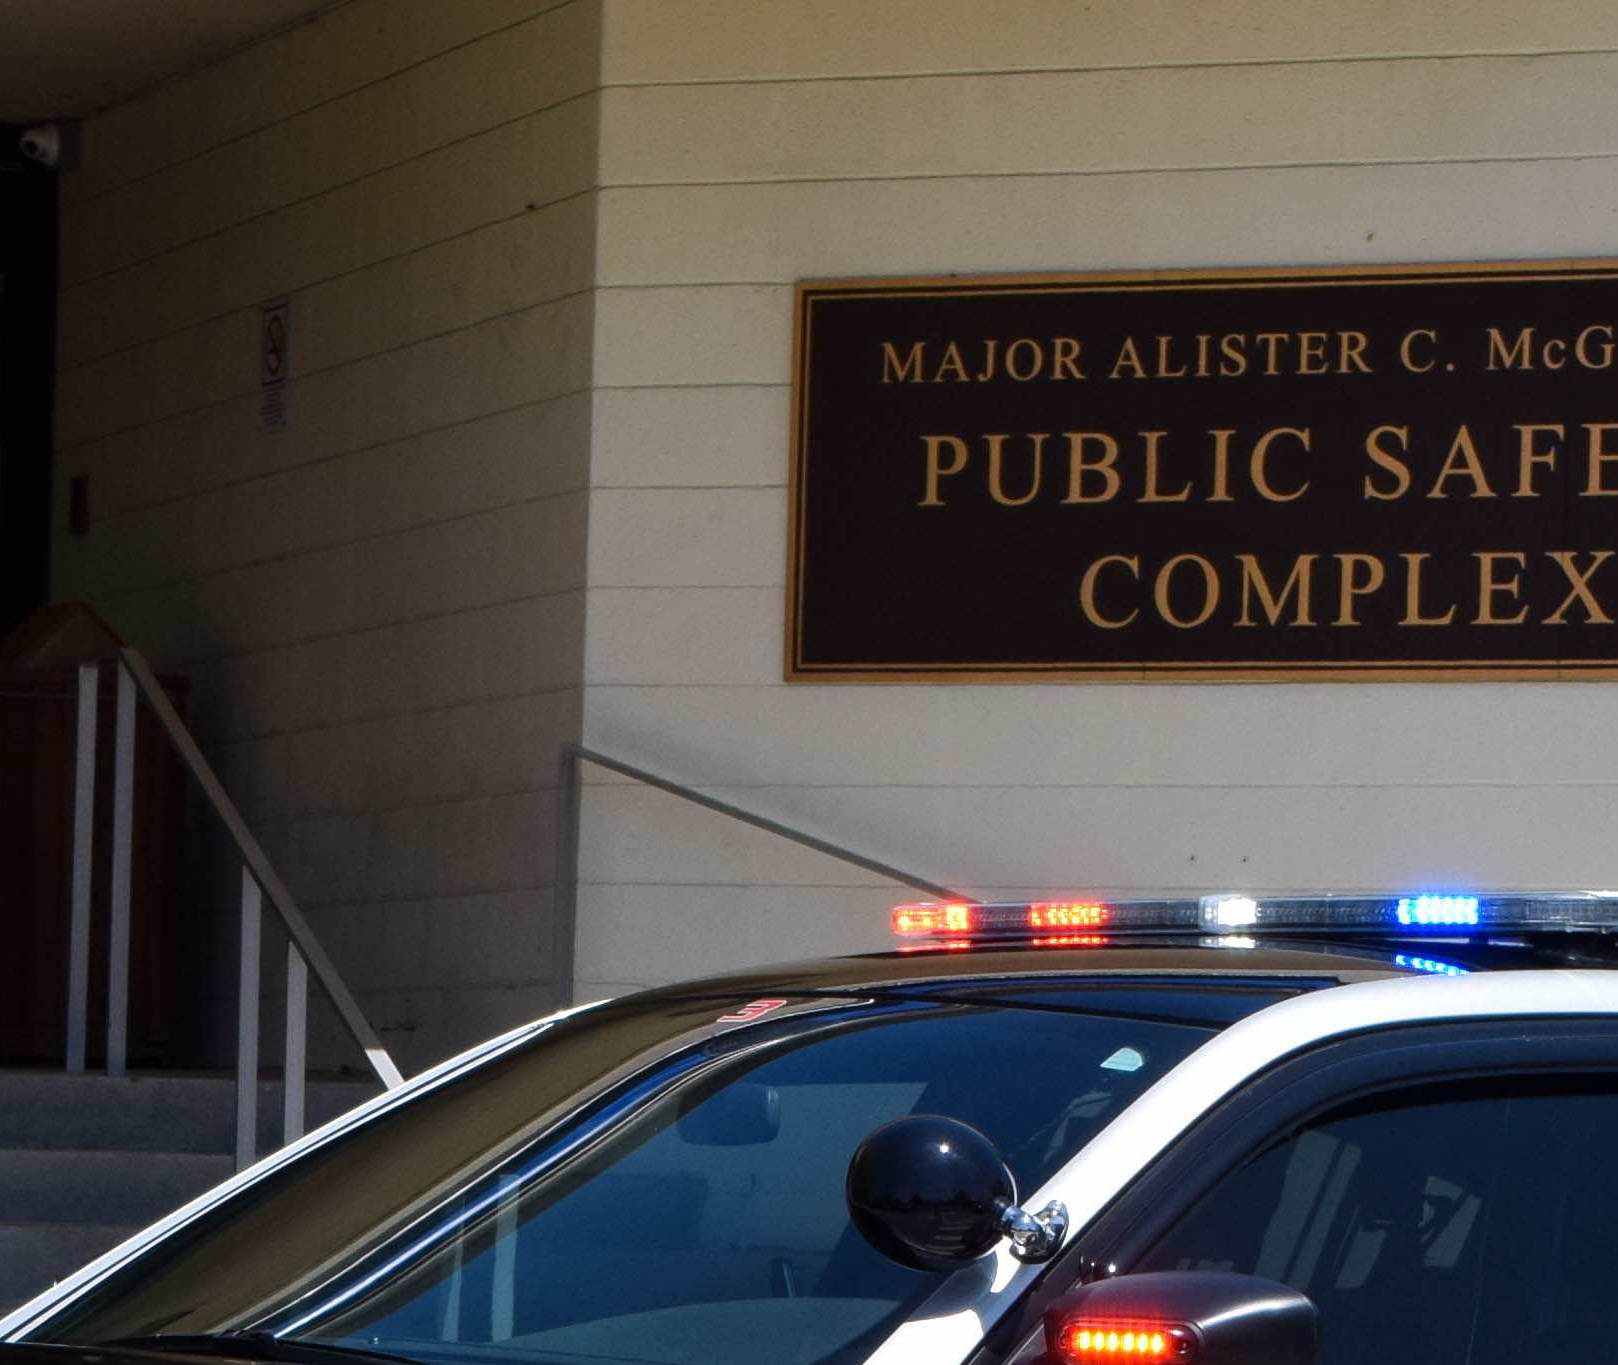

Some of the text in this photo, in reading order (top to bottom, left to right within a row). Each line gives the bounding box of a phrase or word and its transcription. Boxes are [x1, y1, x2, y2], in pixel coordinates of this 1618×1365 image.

[881, 337, 1086, 383] MAJOR
[1108, 331, 1373, 378] ALISTER
[1399, 329, 1456, 373] C.
[918, 427, 1311, 506] PUBLIC
[1079, 550, 1616, 629] COMPLEX
[716, 997, 787, 1022] 3
